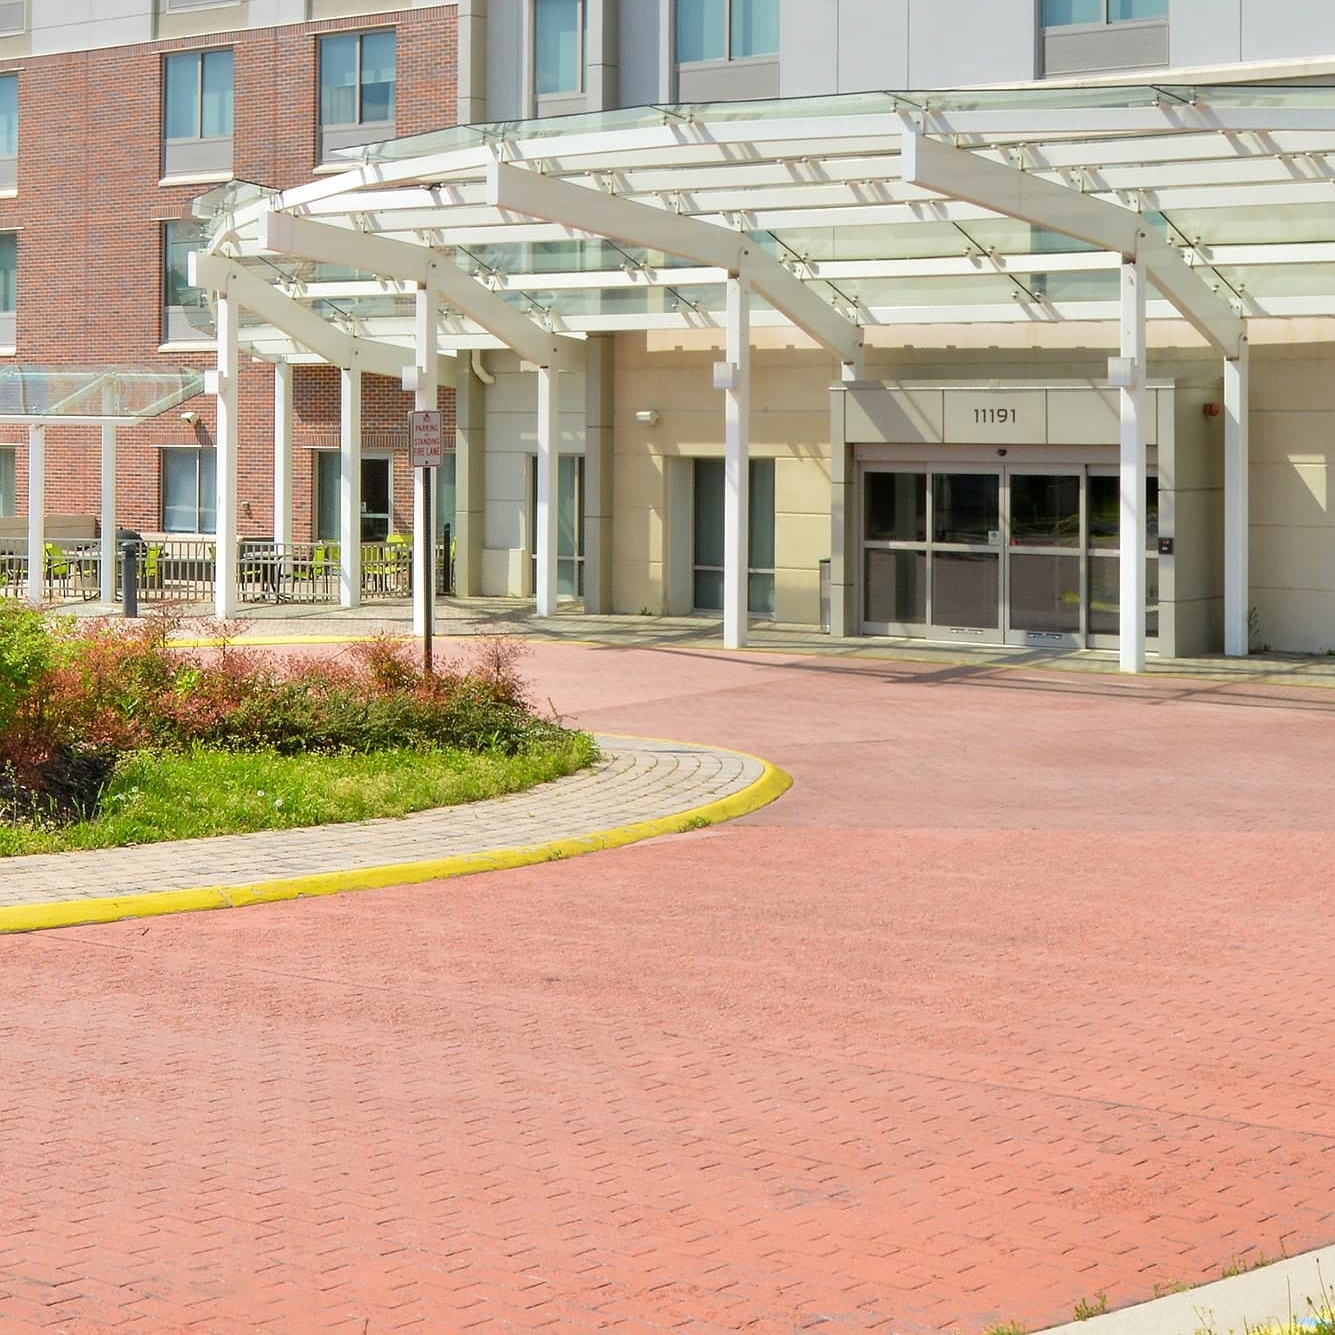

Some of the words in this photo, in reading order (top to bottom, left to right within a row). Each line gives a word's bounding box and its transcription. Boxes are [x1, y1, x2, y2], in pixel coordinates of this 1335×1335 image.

[973, 408, 1016, 424] 11191
[415, 424, 439, 432] PARKING
[414, 437, 440, 445] STANDING
[414, 447, 425, 456] FIRE
[426, 447, 440, 456] LANE
